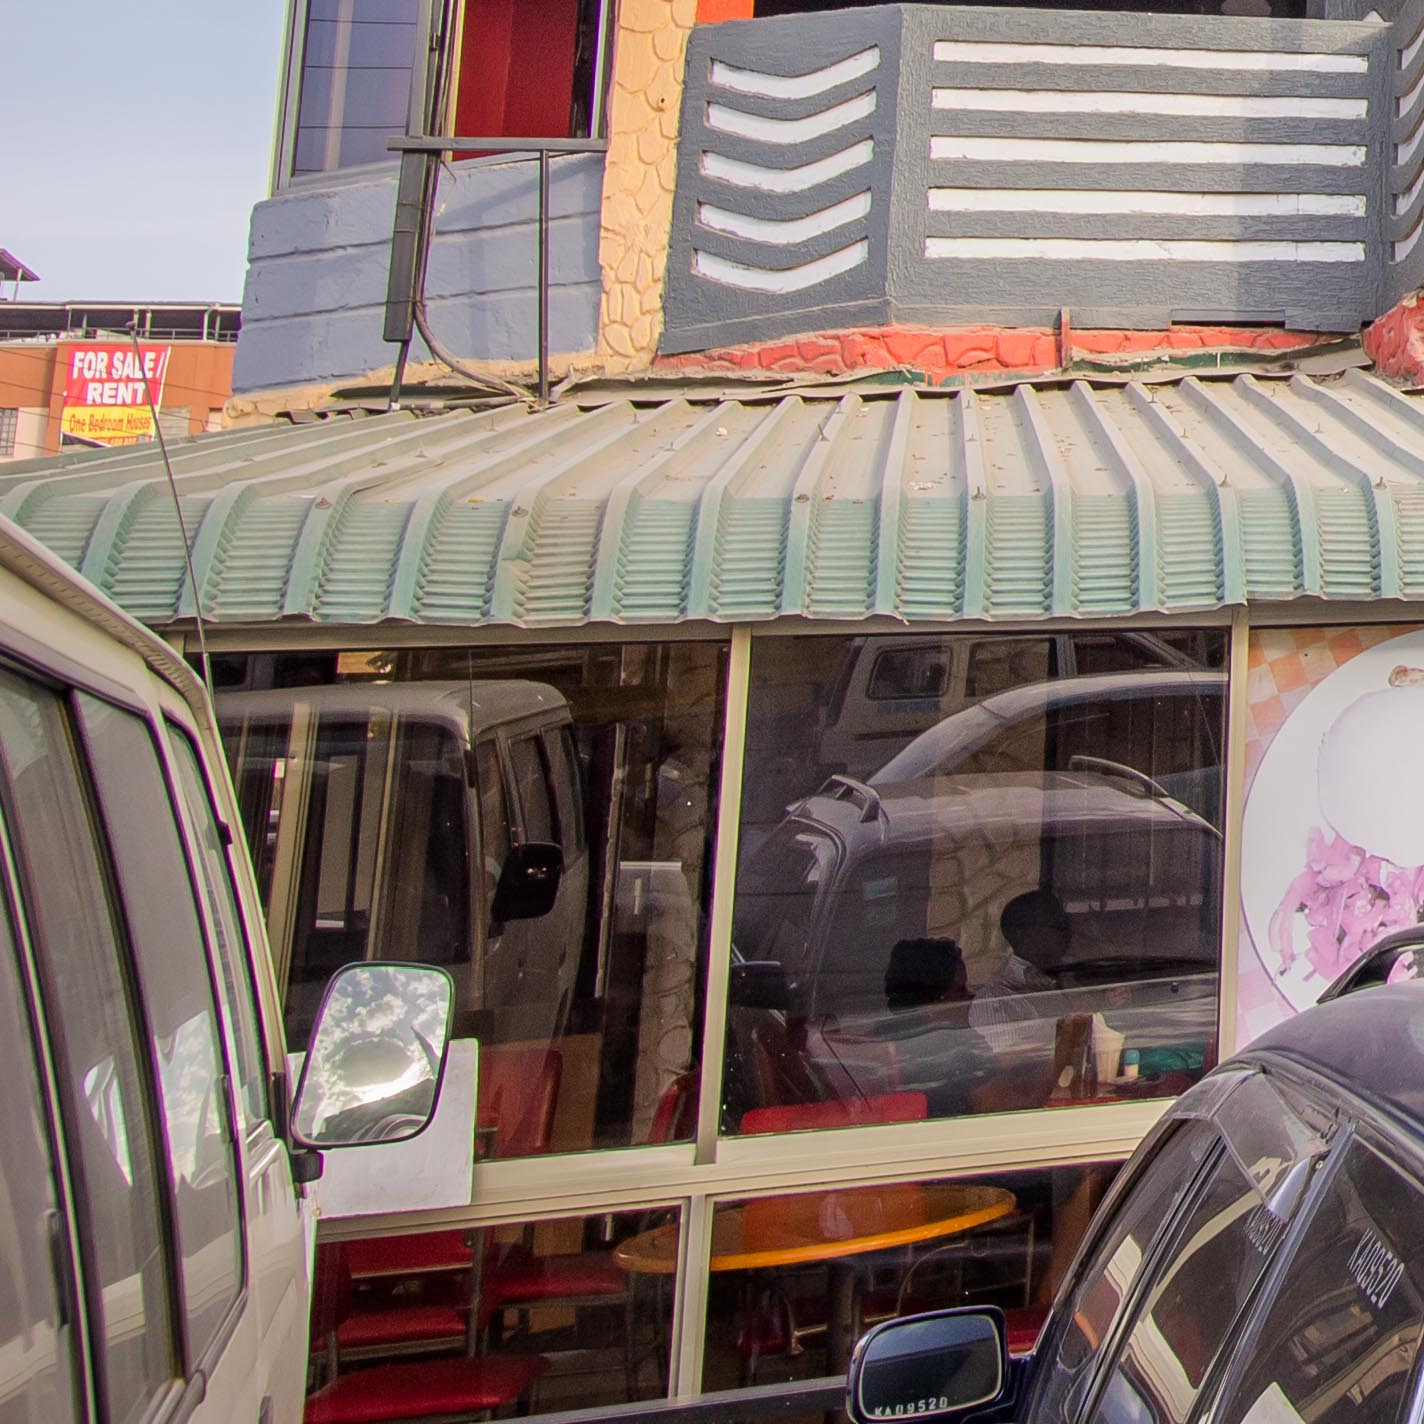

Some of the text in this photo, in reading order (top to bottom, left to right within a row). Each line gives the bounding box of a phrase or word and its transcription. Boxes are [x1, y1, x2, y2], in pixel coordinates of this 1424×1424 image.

[72, 351, 108, 379] FOR
[86, 382, 146, 405] RENT
[70, 413, 86, 433] One
[874, 1396, 948, 1417] KA09520
